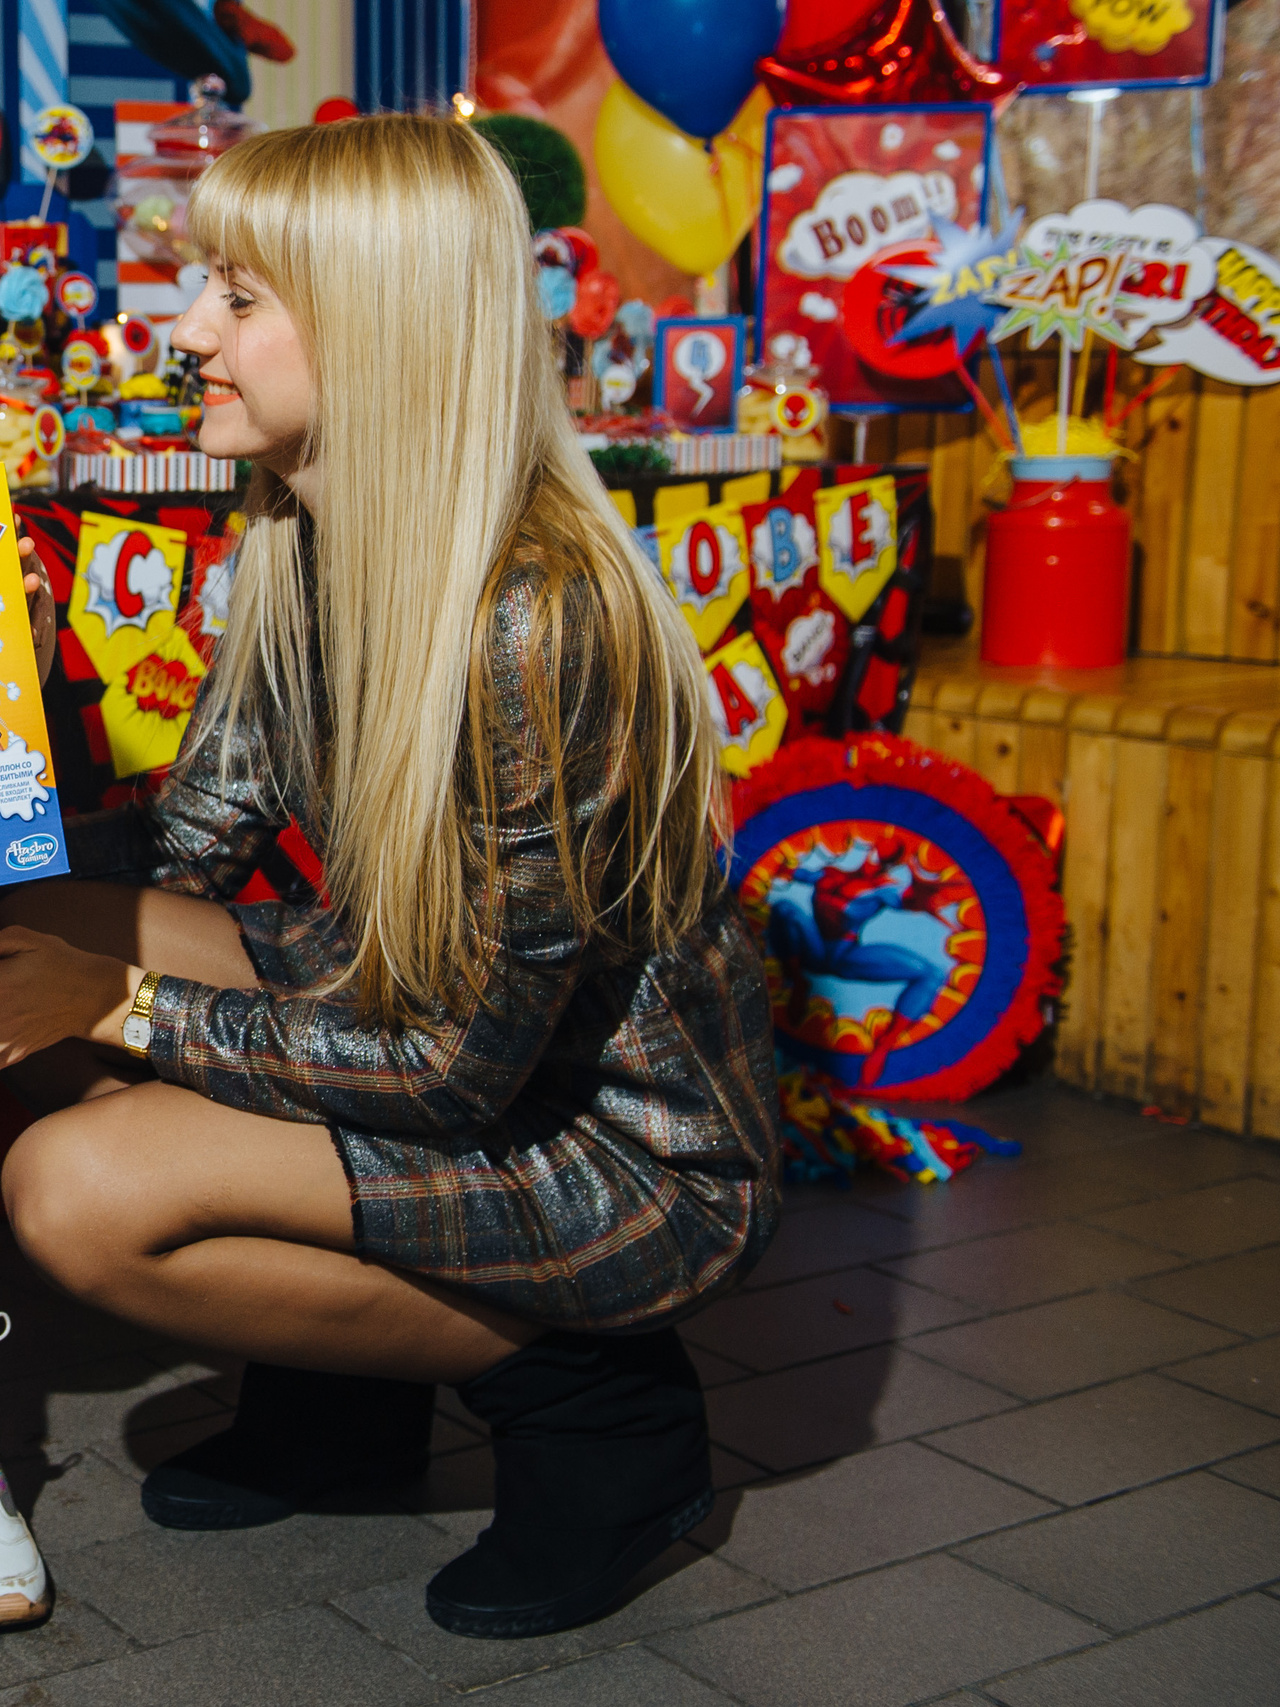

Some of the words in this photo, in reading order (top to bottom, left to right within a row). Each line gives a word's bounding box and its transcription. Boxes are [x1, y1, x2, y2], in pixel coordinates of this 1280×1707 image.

[1004, 252, 1125, 316] ZAP!
[21, 761, 32, 769] СО
[9, 841, 54, 857] Hasbro
[17, 853, 49, 865] Gaming
